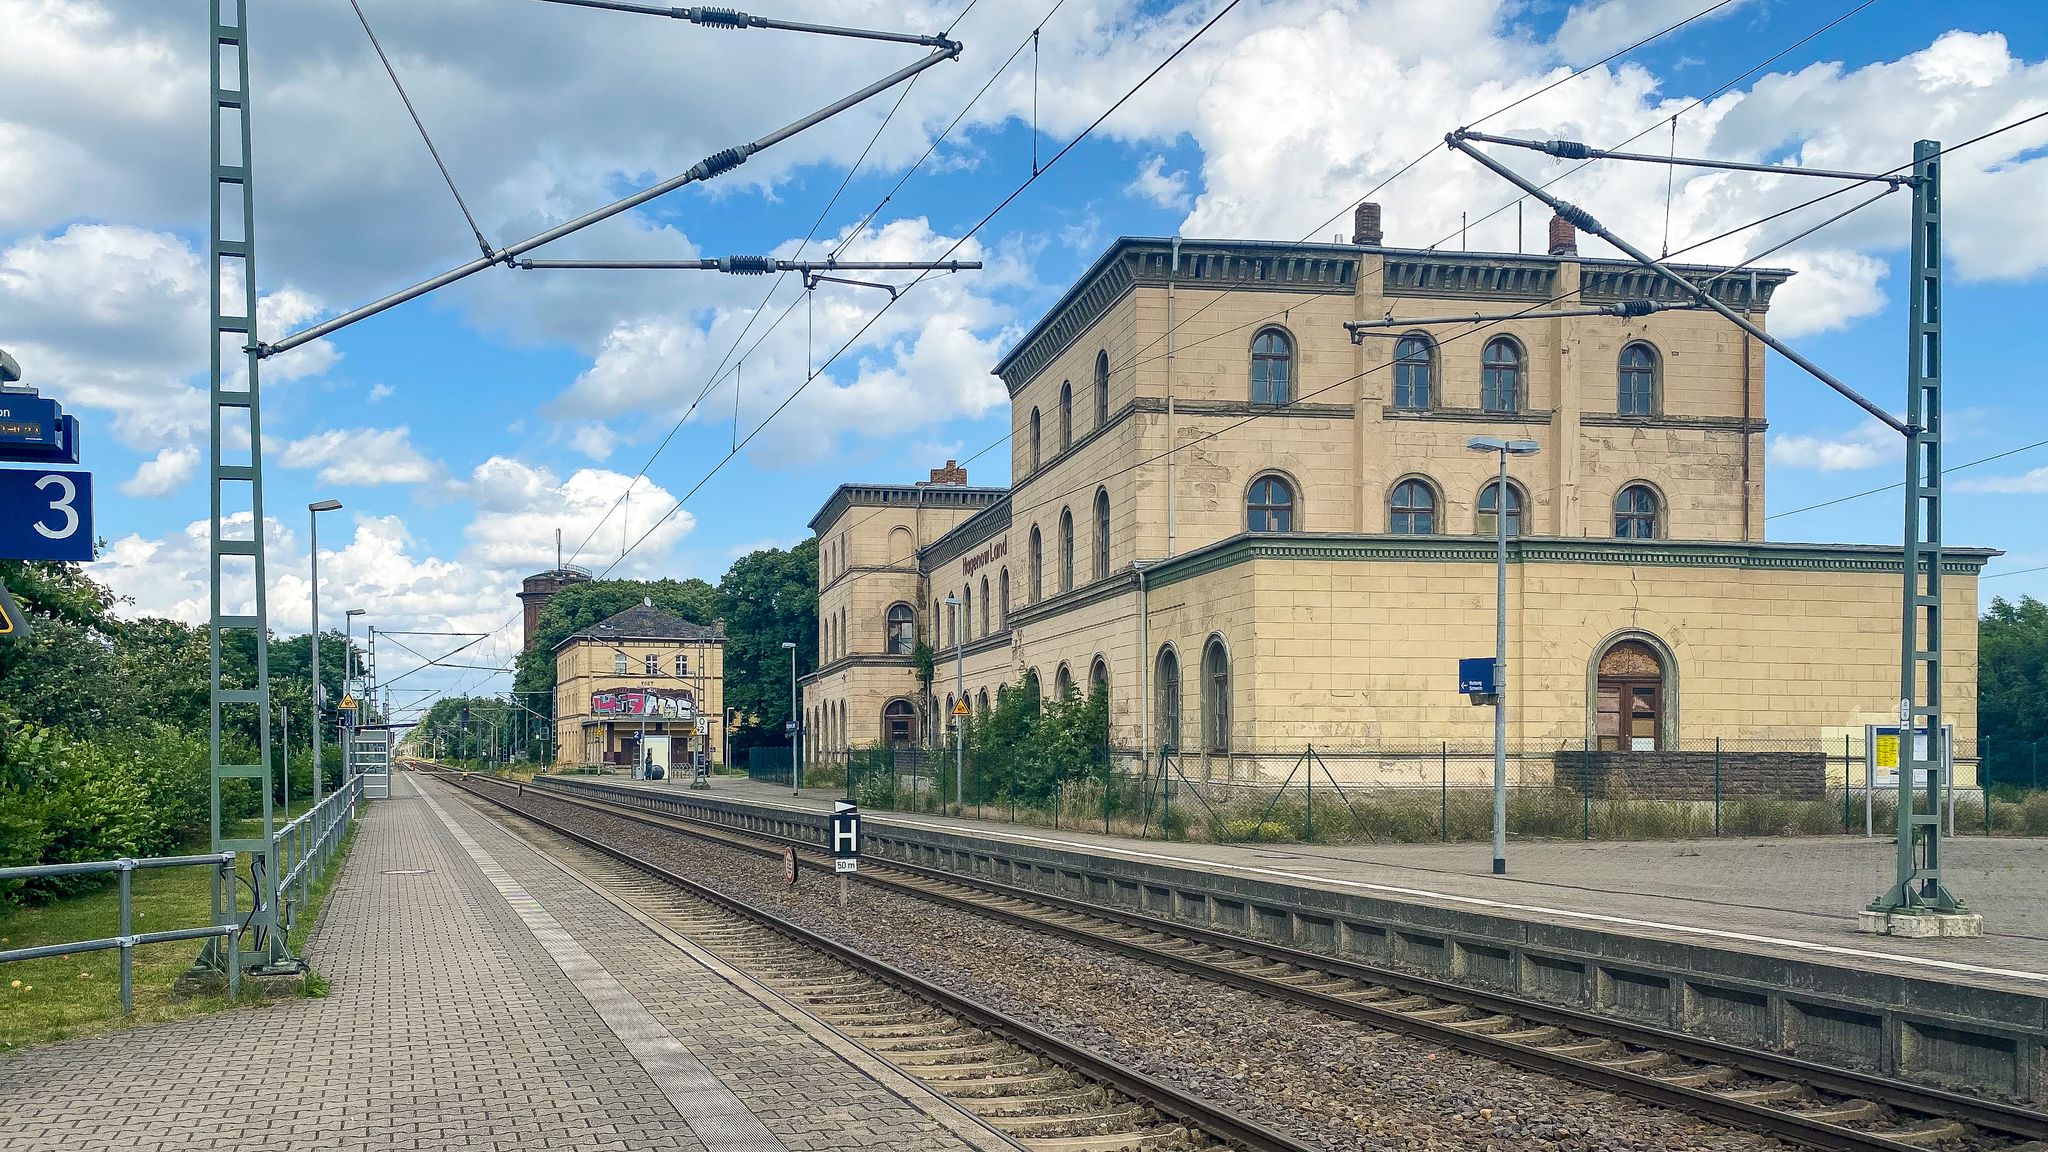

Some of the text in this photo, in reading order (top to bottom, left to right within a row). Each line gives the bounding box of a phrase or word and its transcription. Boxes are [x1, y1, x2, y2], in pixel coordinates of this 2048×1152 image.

[33, 475, 78, 539] 3
[962, 533, 1008, 577] Hagenow Land
[633, 731, 640, 739] 2
[699, 726, 705, 734] 2
[834, 819, 857, 852] H
